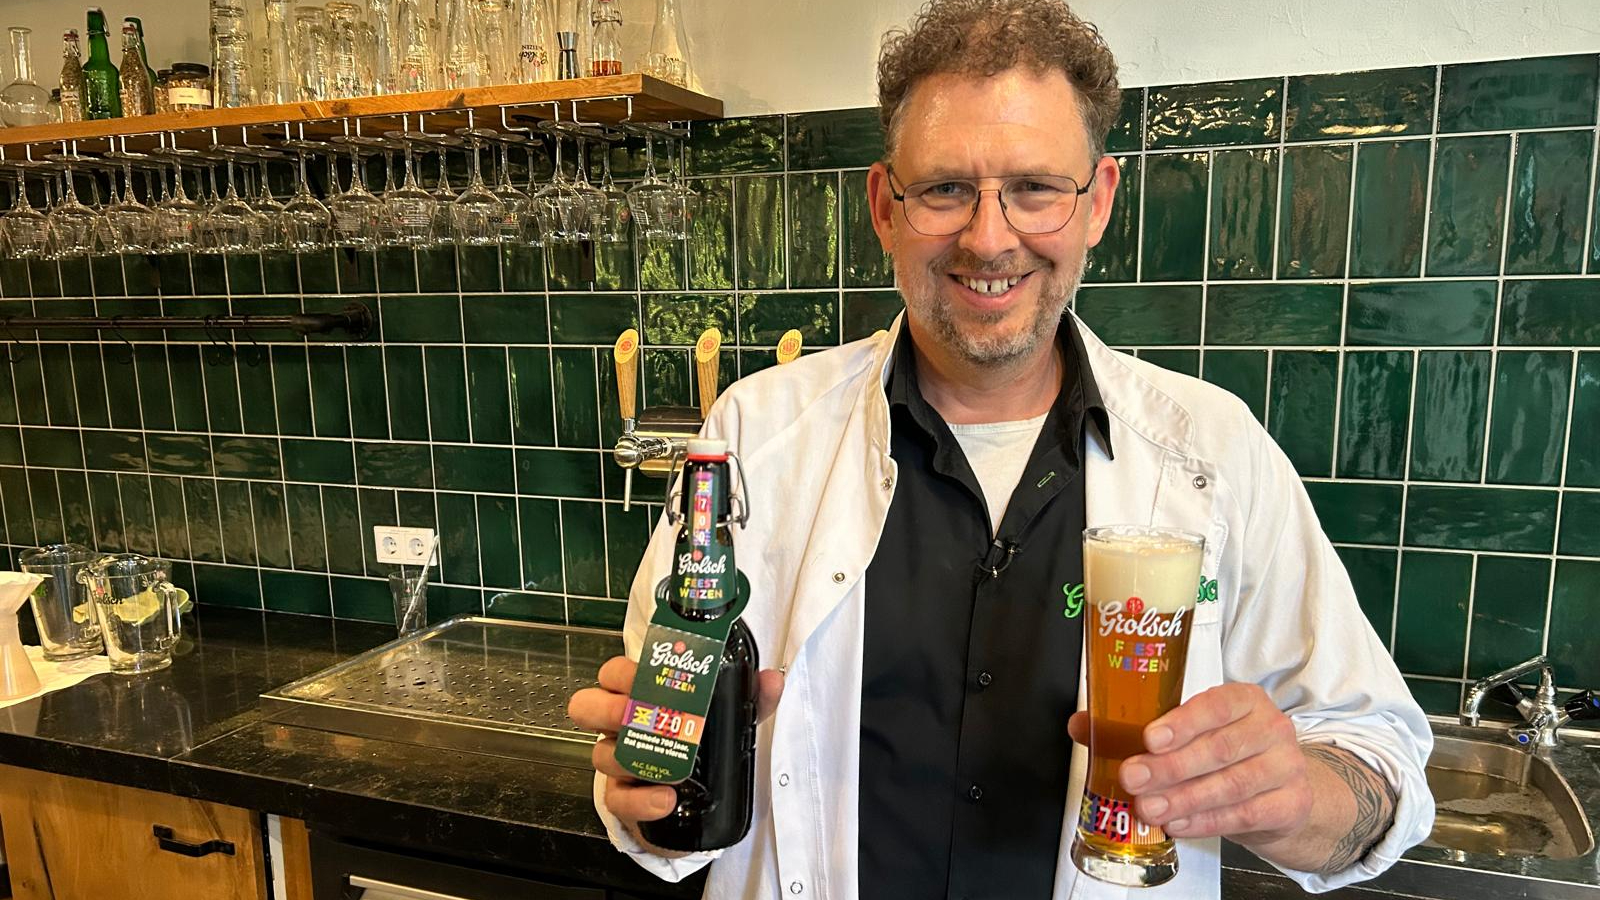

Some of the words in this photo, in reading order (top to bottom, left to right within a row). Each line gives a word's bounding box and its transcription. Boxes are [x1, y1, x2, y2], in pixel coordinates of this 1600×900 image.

[678, 553, 727, 575] Grolsch
[684, 577, 719, 588] FEEST
[679, 588, 723, 599] WEIZEN
[1097, 600, 1186, 637] Grolsch
[649, 641, 715, 675] Grolsch
[1108, 653, 1170, 673] WEIZEN
[655, 675, 696, 693] WEIZEN
[661, 667, 694, 683] FEEST
[657, 713, 695, 737] 700
[623, 736, 636, 747] Dat
[636, 741, 654, 751] gaan
[627, 729, 661, 745] Enschede
[660, 738, 674, 748] 700
